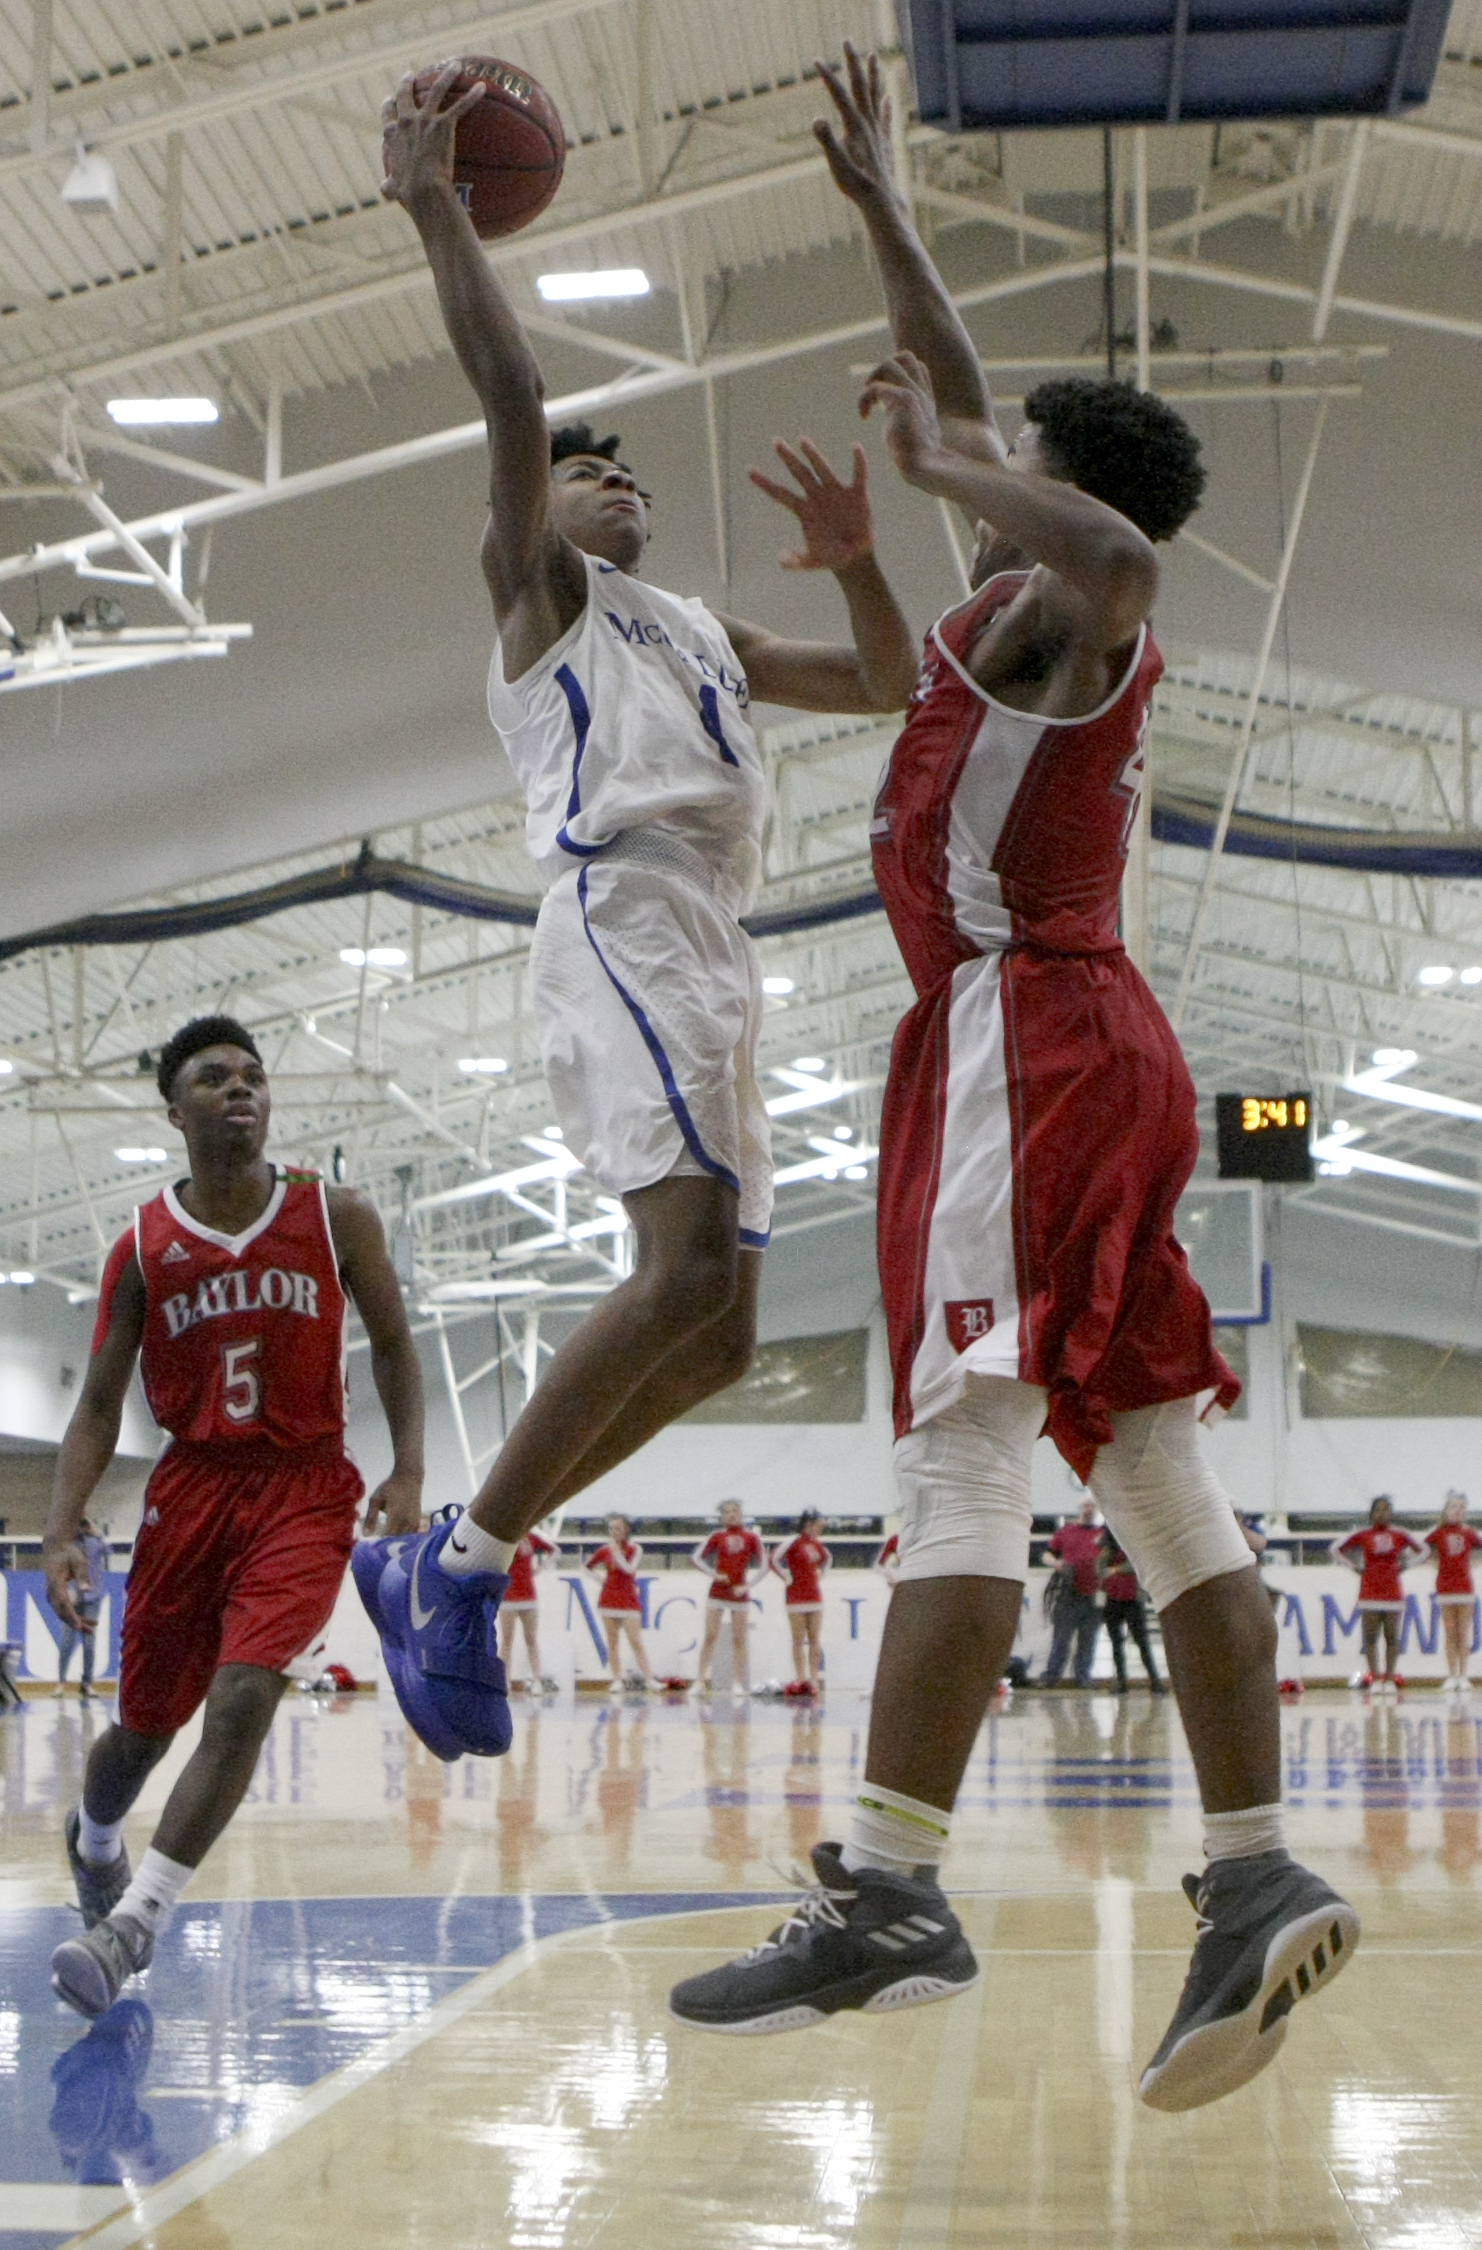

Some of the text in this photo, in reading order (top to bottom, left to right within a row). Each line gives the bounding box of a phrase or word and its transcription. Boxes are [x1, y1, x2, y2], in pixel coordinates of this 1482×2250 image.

[1242, 1098, 1305, 1130] 3:41
[162, 1267, 319, 1337] BAYLOR
[961, 1306, 988, 1342] B
[224, 1340, 260, 1421] 5
